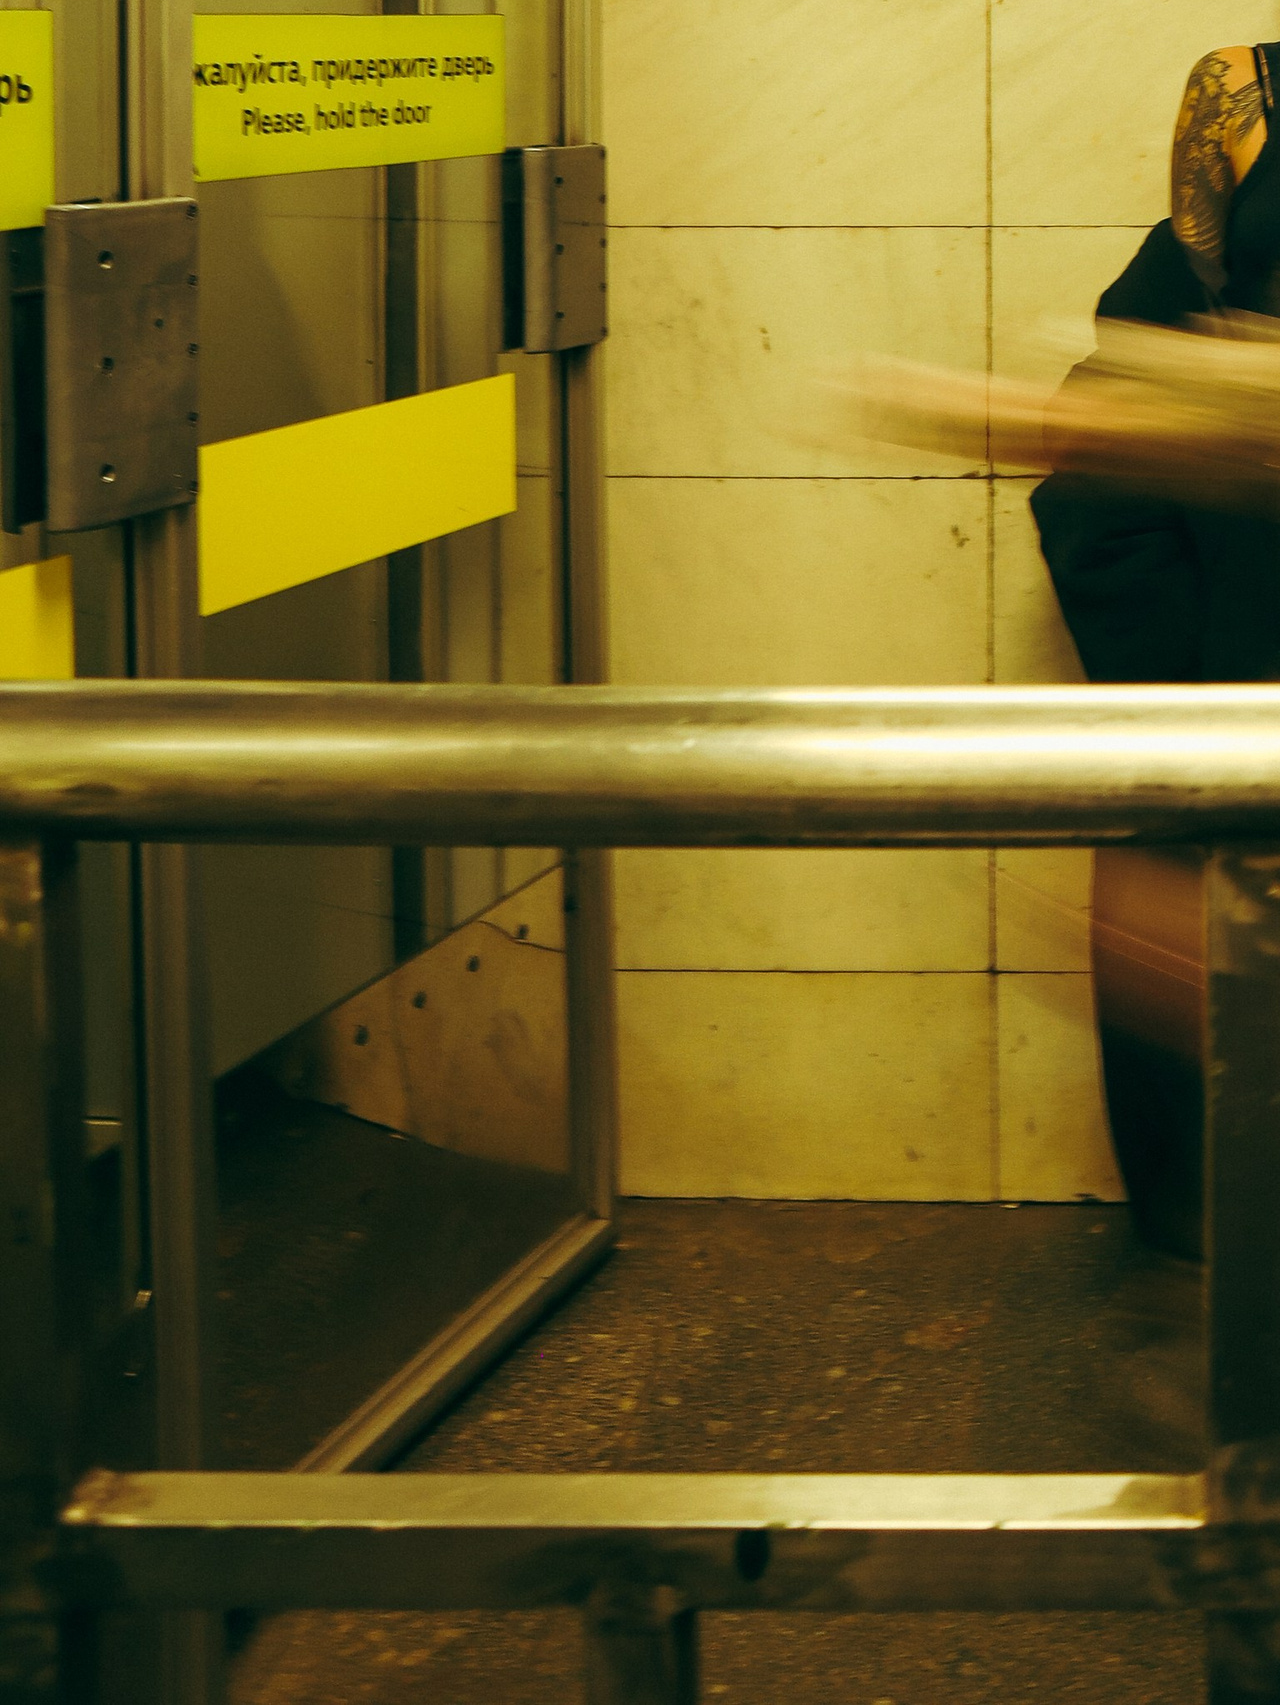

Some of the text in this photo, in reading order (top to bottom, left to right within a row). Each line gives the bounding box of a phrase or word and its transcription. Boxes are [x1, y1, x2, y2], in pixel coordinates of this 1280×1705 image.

[312, 57, 438, 90] придержите
[441, 56, 496, 84] дверь
[242, 99, 432, 136] Please, hold the door
